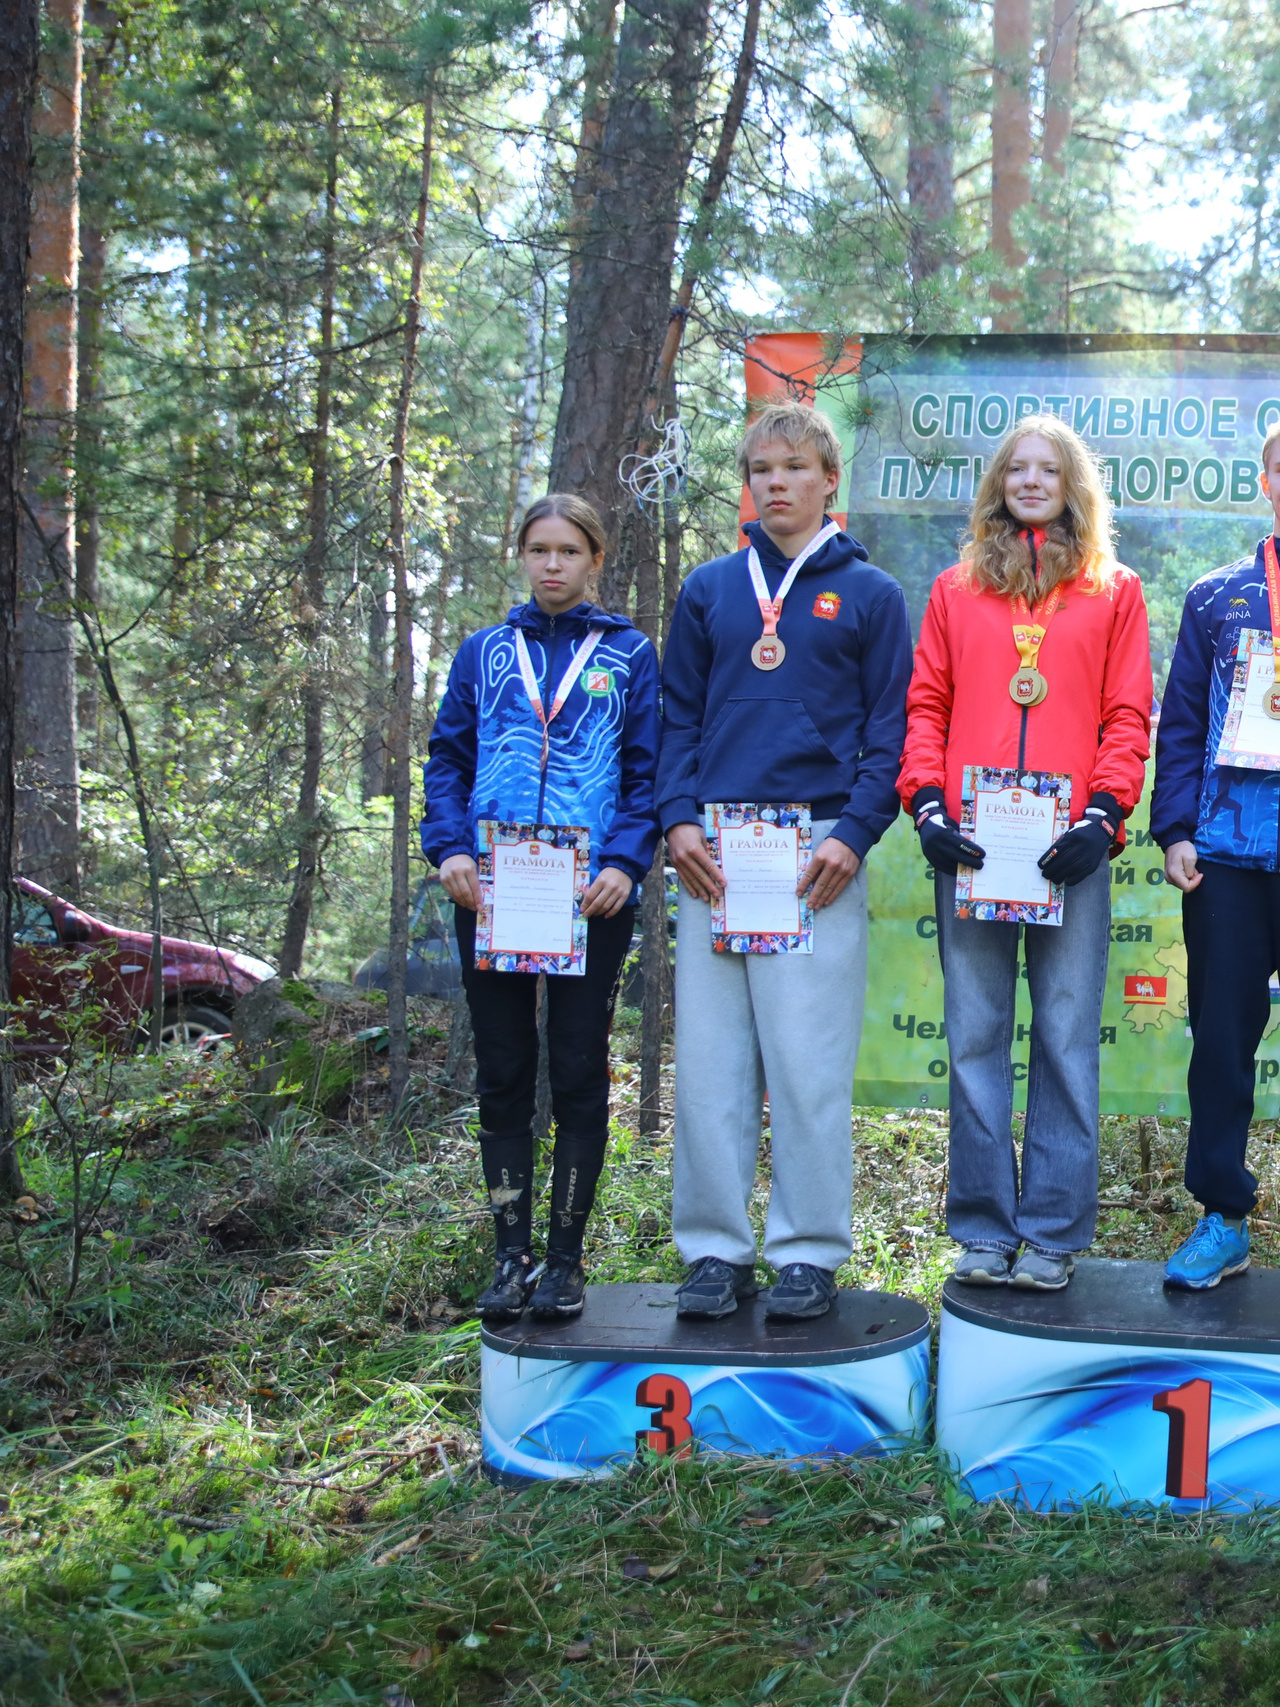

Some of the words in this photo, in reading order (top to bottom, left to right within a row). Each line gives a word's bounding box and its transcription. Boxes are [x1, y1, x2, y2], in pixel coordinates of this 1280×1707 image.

[911, 393, 1238, 439] СПОРТИВНОЕ
[985, 803, 1046, 818] ГРАМОТА
[503, 855, 566, 869] ГРАМОТА
[729, 838, 789, 849] ГРАМОТА
[565, 1167, 577, 1211] NORD
[635, 1373, 694, 1459] 3
[1152, 1377, 1213, 1499] 1
